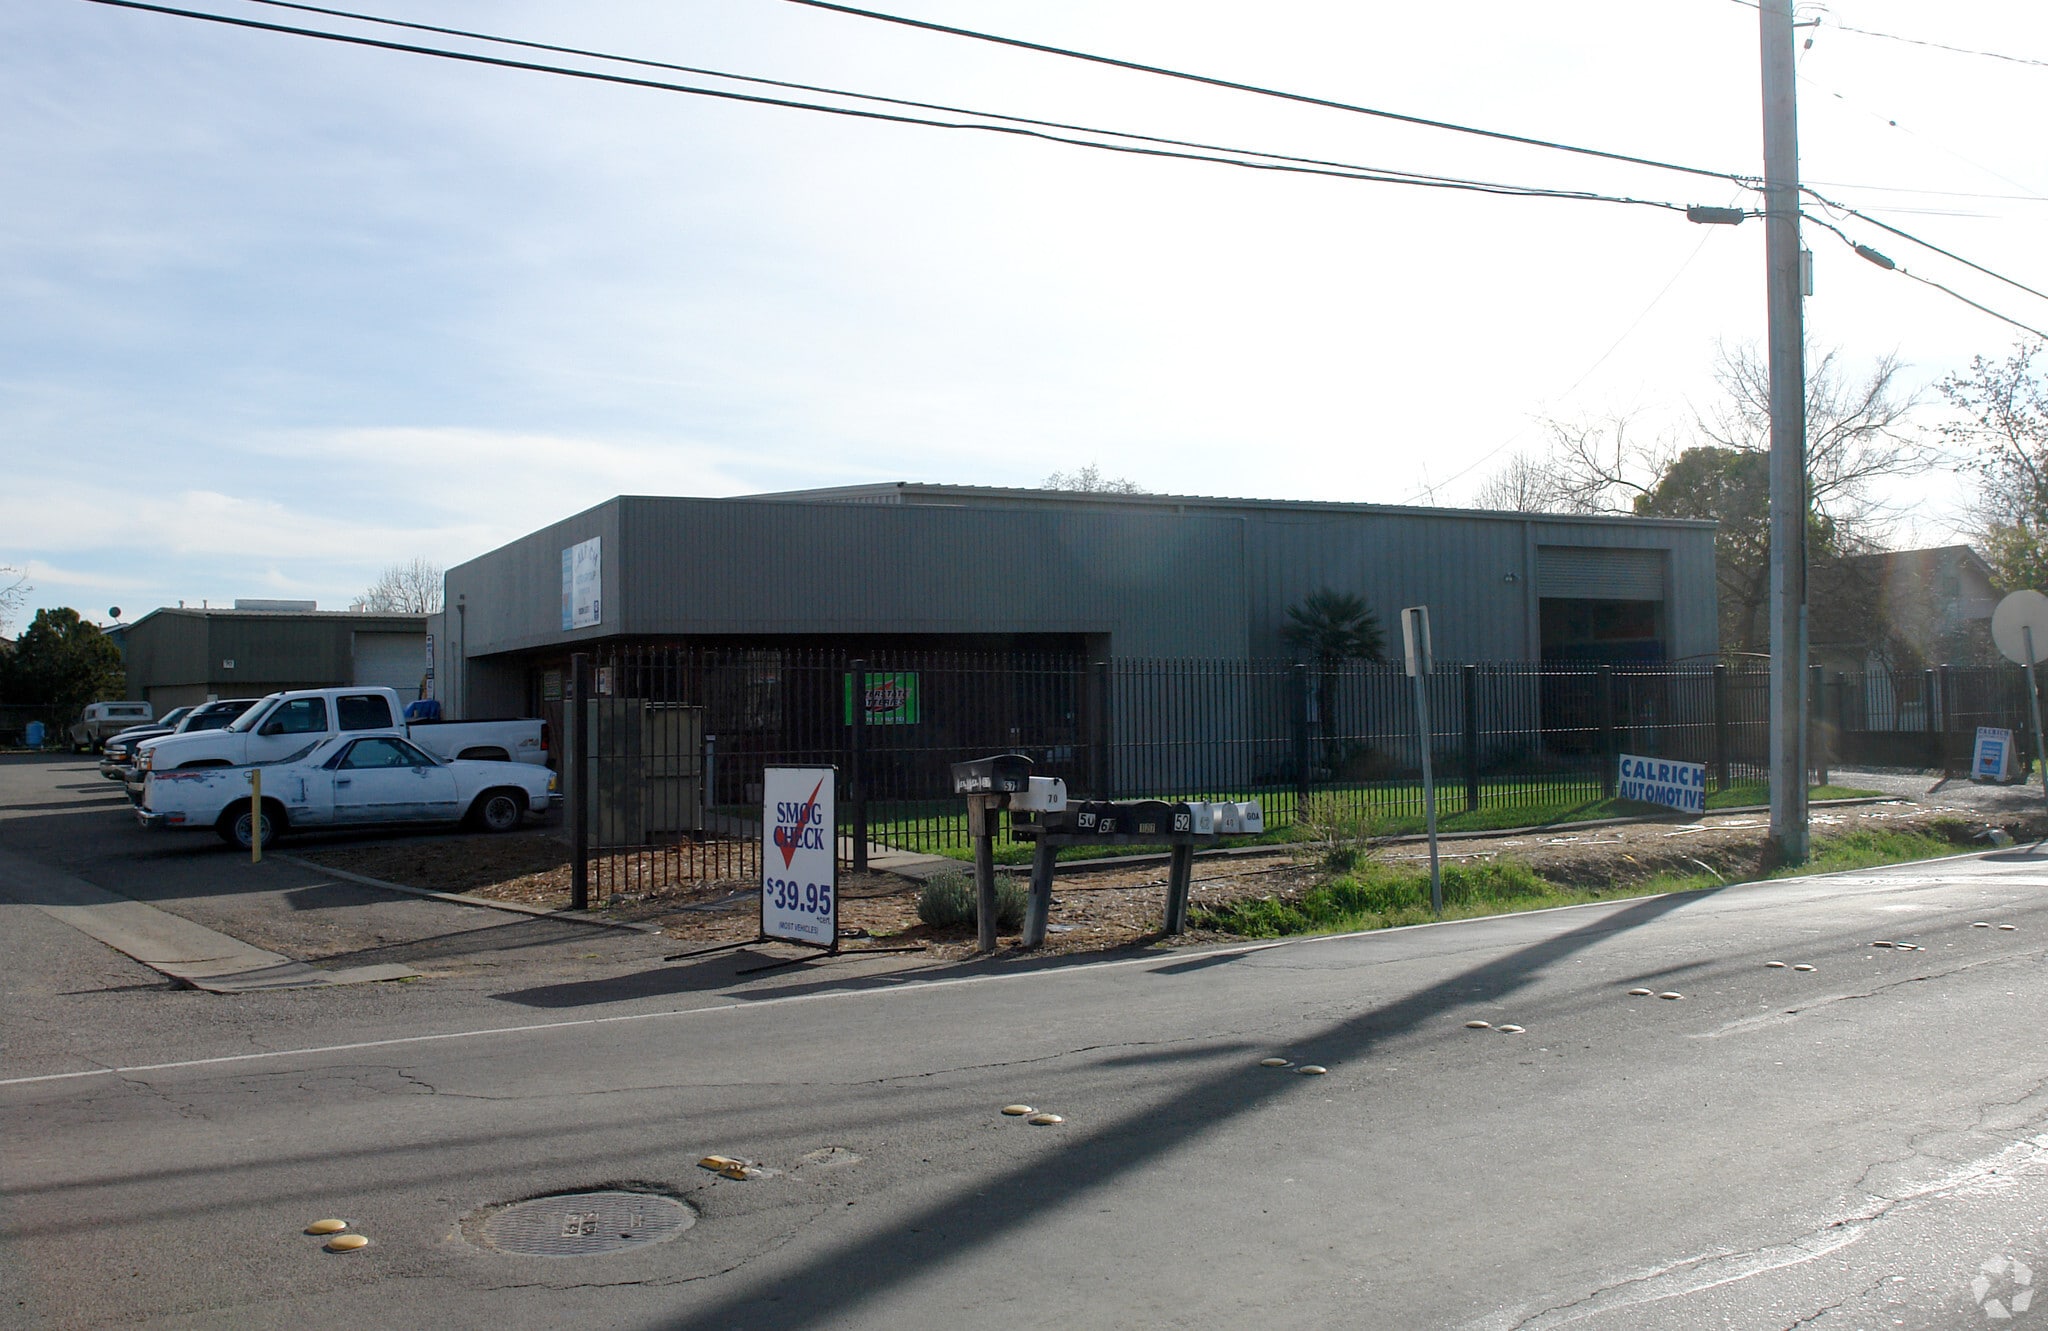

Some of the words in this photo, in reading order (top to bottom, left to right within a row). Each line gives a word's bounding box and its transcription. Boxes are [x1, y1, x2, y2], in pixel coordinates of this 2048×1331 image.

[1621, 759, 1705, 787] CALRICH
[1048, 794, 1058, 803] 70
[1620, 780, 1705, 809] AUTOMOTIVE
[777, 801, 823, 826] SMOG
[1079, 814, 1095, 827] 50
[1175, 815, 1188, 831] 52
[773, 825, 825, 850] CHECK
[766, 877, 831, 916] $39.95
